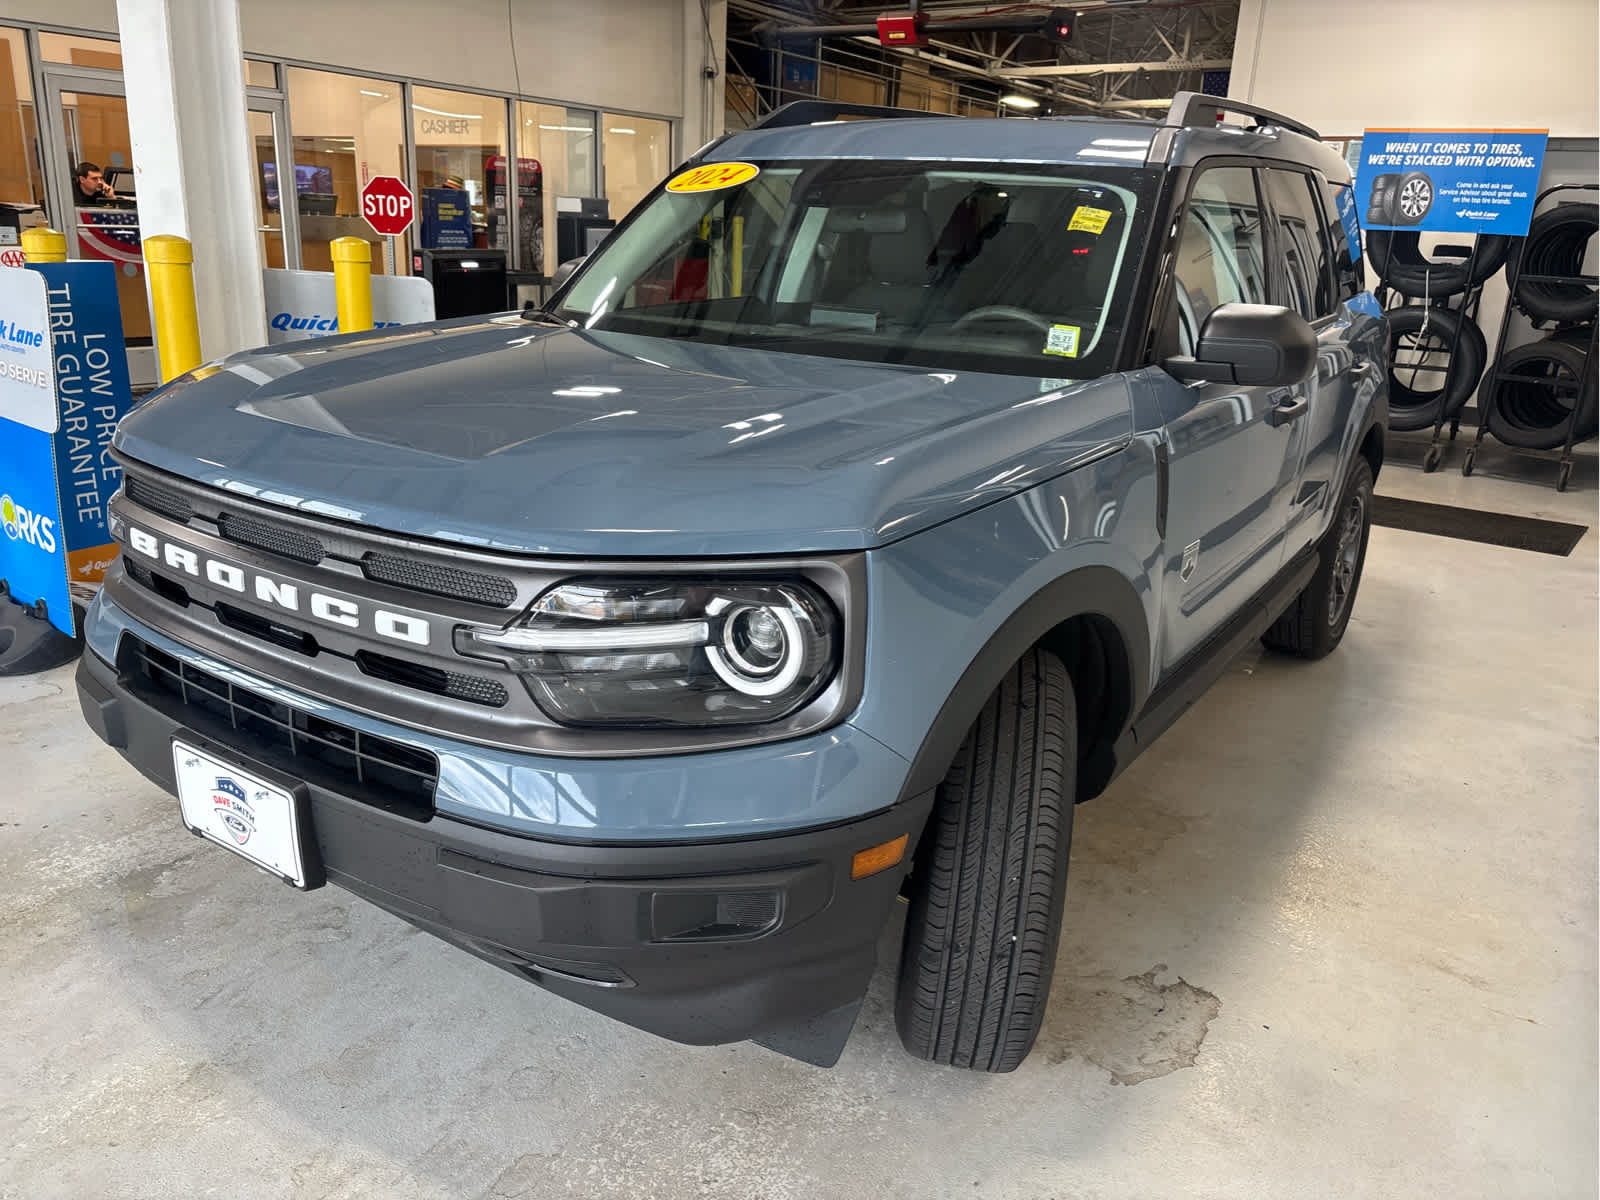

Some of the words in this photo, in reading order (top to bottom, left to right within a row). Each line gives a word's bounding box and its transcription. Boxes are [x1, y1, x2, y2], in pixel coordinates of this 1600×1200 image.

[420, 119, 470, 134] CASHIER
[1368, 154, 1402, 165] WE'RE
[1404, 155, 1451, 166] STACKED
[1455, 156, 1483, 167] WITH
[1485, 156, 1536, 168] OPTIONS.
[1385, 142, 1417, 153] WHEN
[1420, 142, 1433, 153] IT
[1433, 143, 1471, 154] COMES
[1473, 143, 1488, 154] TO
[1491, 143, 1524, 156] TIRES,
[670, 167, 749, 188] 2024
[365, 194, 411, 217] STOP
[48, 282, 76, 345] TIRE
[9, 322, 43, 348] Lane
[9, 364, 48, 389] SERVE
[83, 333, 114, 396] LOW
[129, 526, 430, 646] BRONCO
[212, 794, 231, 808] DAVE
[231, 800, 255, 825] SMITH
